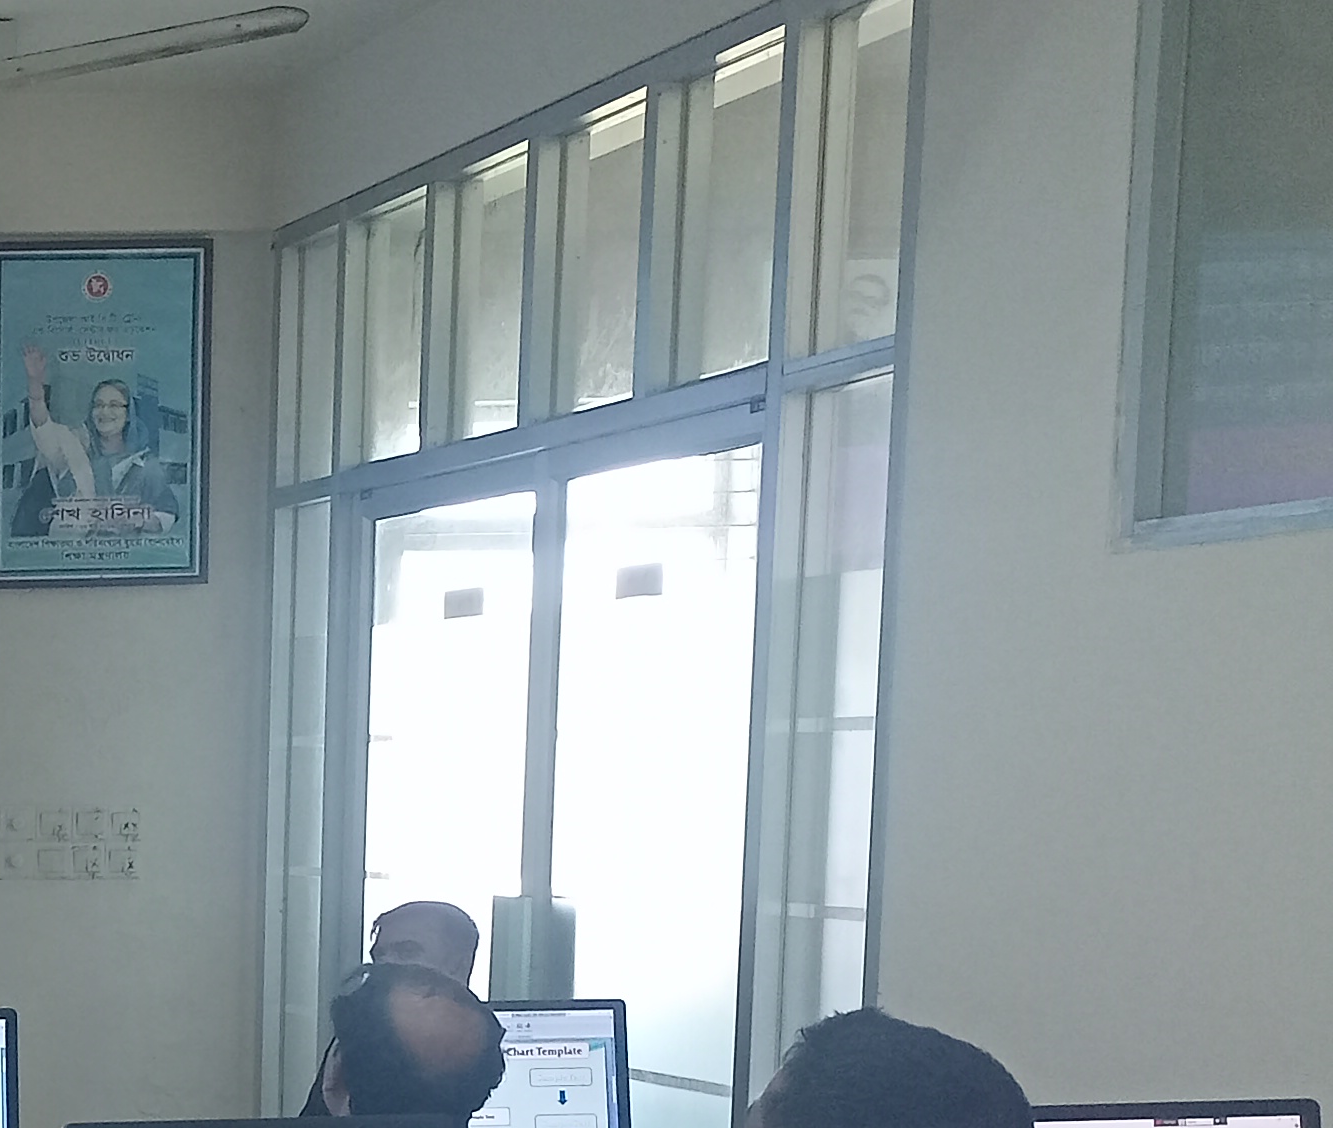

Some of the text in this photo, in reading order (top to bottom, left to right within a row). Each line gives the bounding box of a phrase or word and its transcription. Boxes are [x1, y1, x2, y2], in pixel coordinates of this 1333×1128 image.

[85, 345, 136, 363] উদ্বোধন
[90, 502, 153, 521] হাসিনা
[506, 1045, 583, 1058] Chart Template
